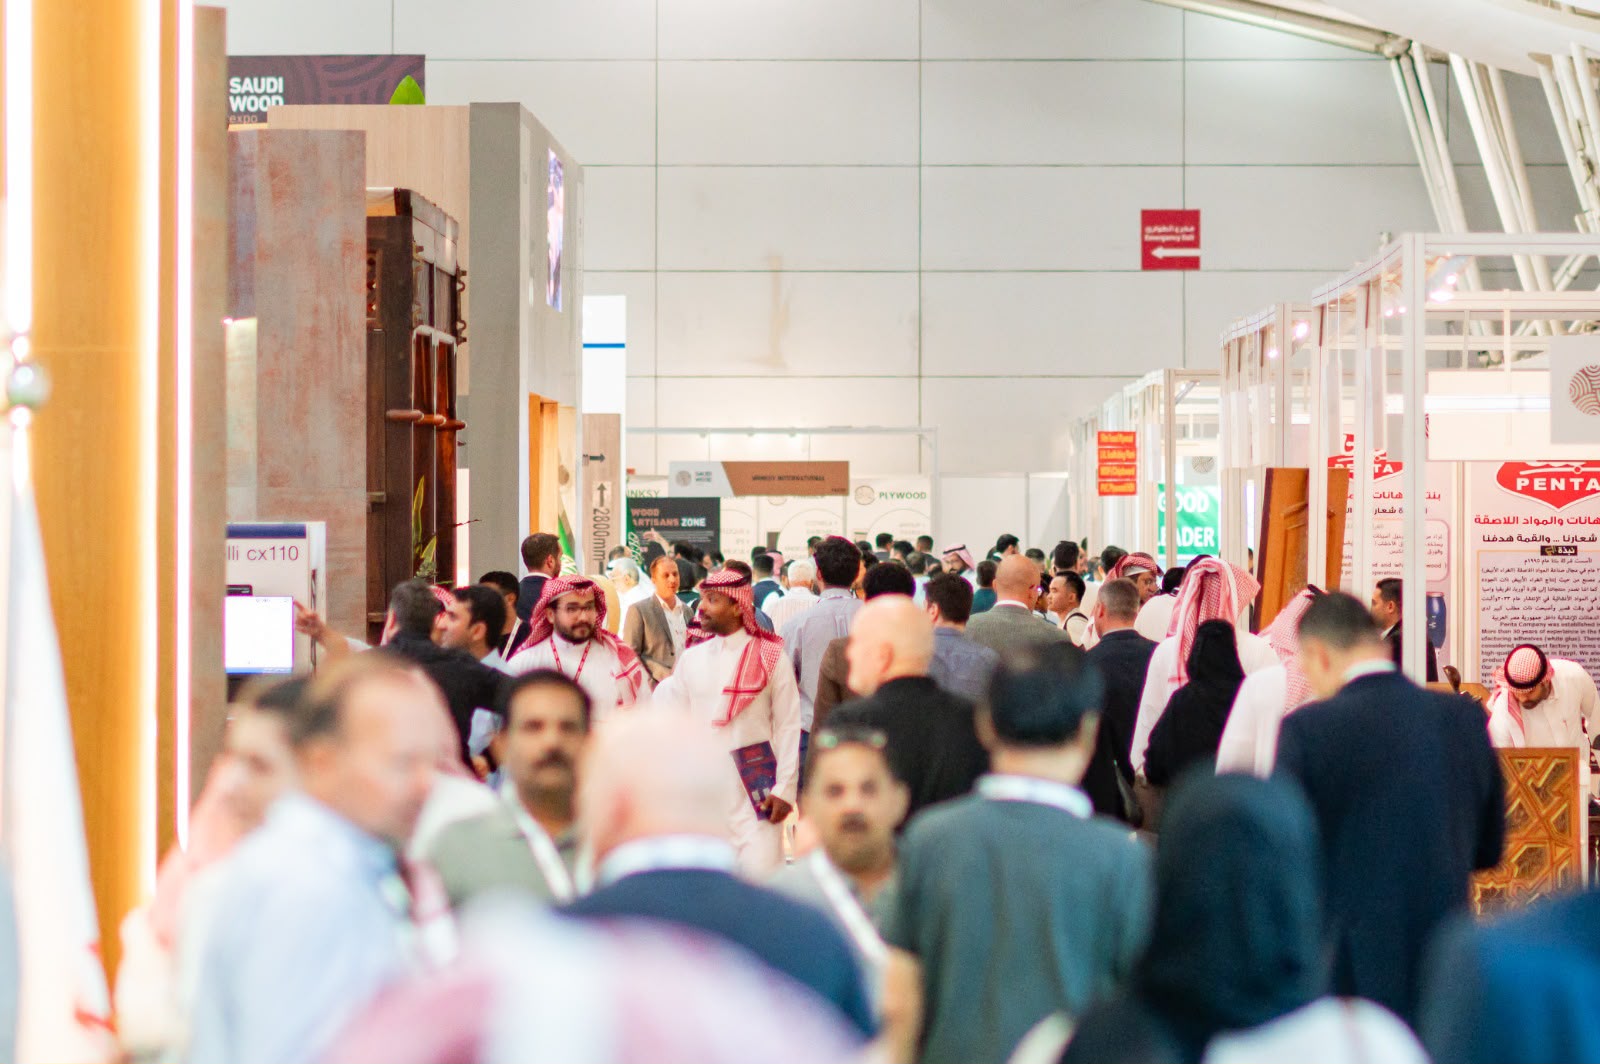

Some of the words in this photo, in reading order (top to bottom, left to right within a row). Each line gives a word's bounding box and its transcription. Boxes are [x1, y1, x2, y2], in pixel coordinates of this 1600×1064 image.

[229, 76, 284, 94] SAUDI
[229, 95, 284, 112] WOOD
[229, 114, 258, 123] expo
[1516, 477, 1600, 491] PENTA
[626, 489, 660, 498] INKSY
[879, 491, 927, 500] PLYWOOD
[631, 508, 659, 517] WOOD
[681, 517, 706, 527] ZONE
[1474, 514, 1519, 525] اللاصقة
[1522, 515, 1564, 526] والمواد
[593, 508, 611, 561] 2800mm
[1482, 534, 1514, 543] هدفنا
[1516, 533, 1551, 544] والقمة
[1563, 533, 1598, 544] شعارنا
[246, 545, 299, 561] cx110
[1557, 547, 1575, 556] نبذة
